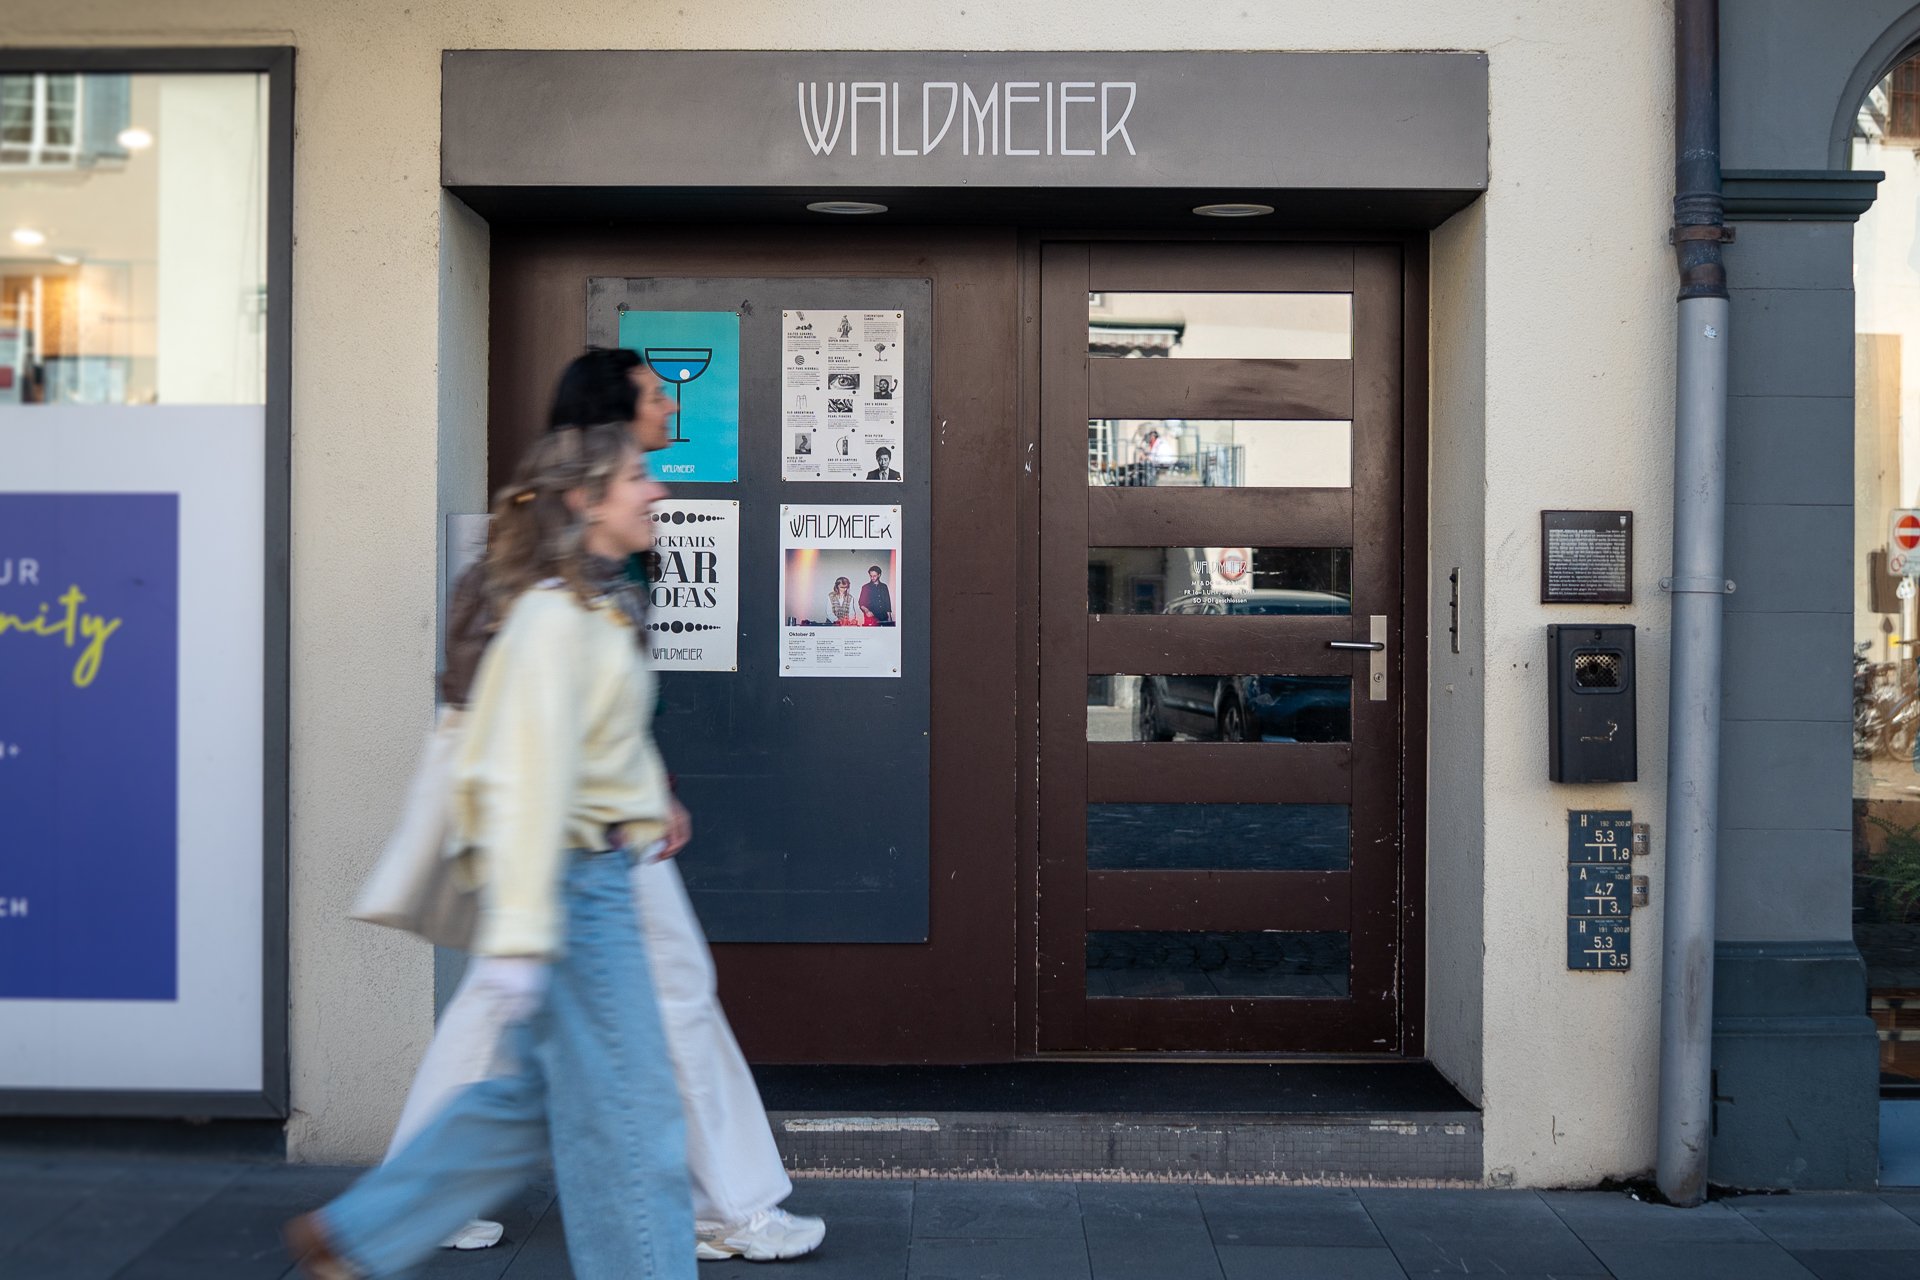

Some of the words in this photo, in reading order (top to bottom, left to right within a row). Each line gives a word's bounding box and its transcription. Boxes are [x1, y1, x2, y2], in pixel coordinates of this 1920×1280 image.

[799, 82, 1136, 156] WALDMEIER
[649, 535, 715, 548] OCKTAILS
[647, 586, 717, 609] OFAS
[652, 648, 703, 661] WALDMEIER
[1581, 814, 1587, 827] H
[1580, 867, 1587, 880] A
[1580, 920, 1586, 933] H
